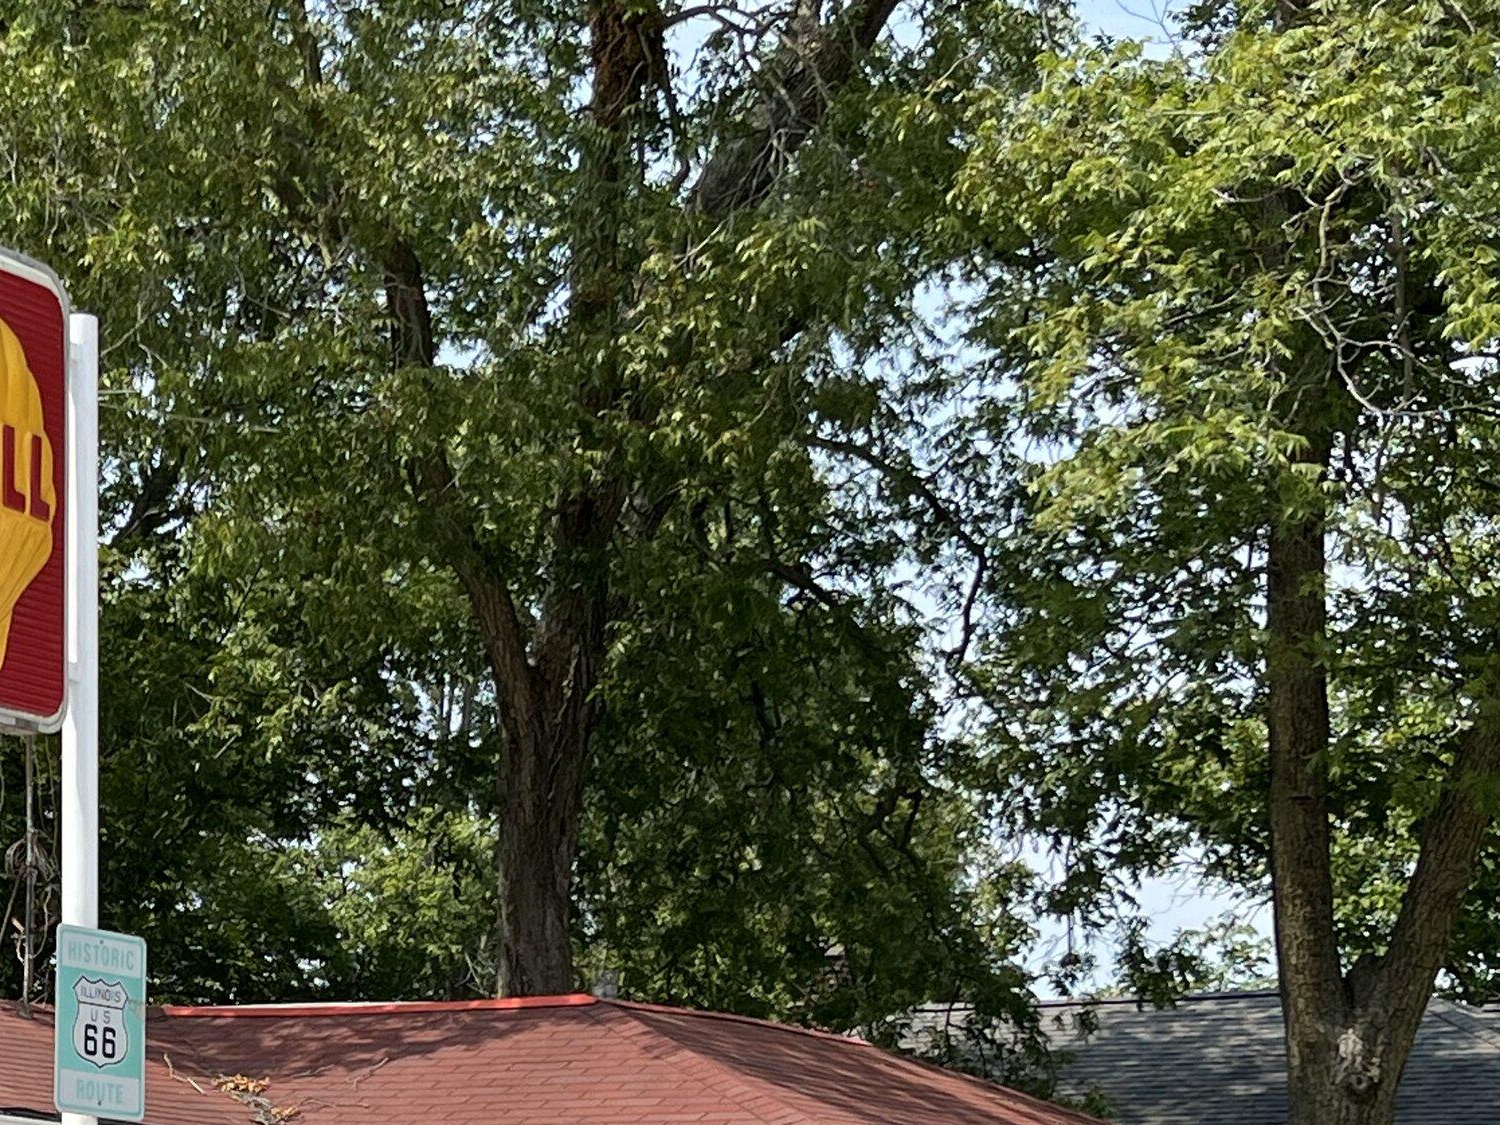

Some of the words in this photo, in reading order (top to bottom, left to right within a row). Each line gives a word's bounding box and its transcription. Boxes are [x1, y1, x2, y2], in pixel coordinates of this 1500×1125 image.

[68, 941, 134, 970] HISTORIC
[84, 1023, 116, 1058] 66
[76, 1079, 124, 1104] ROUTE
